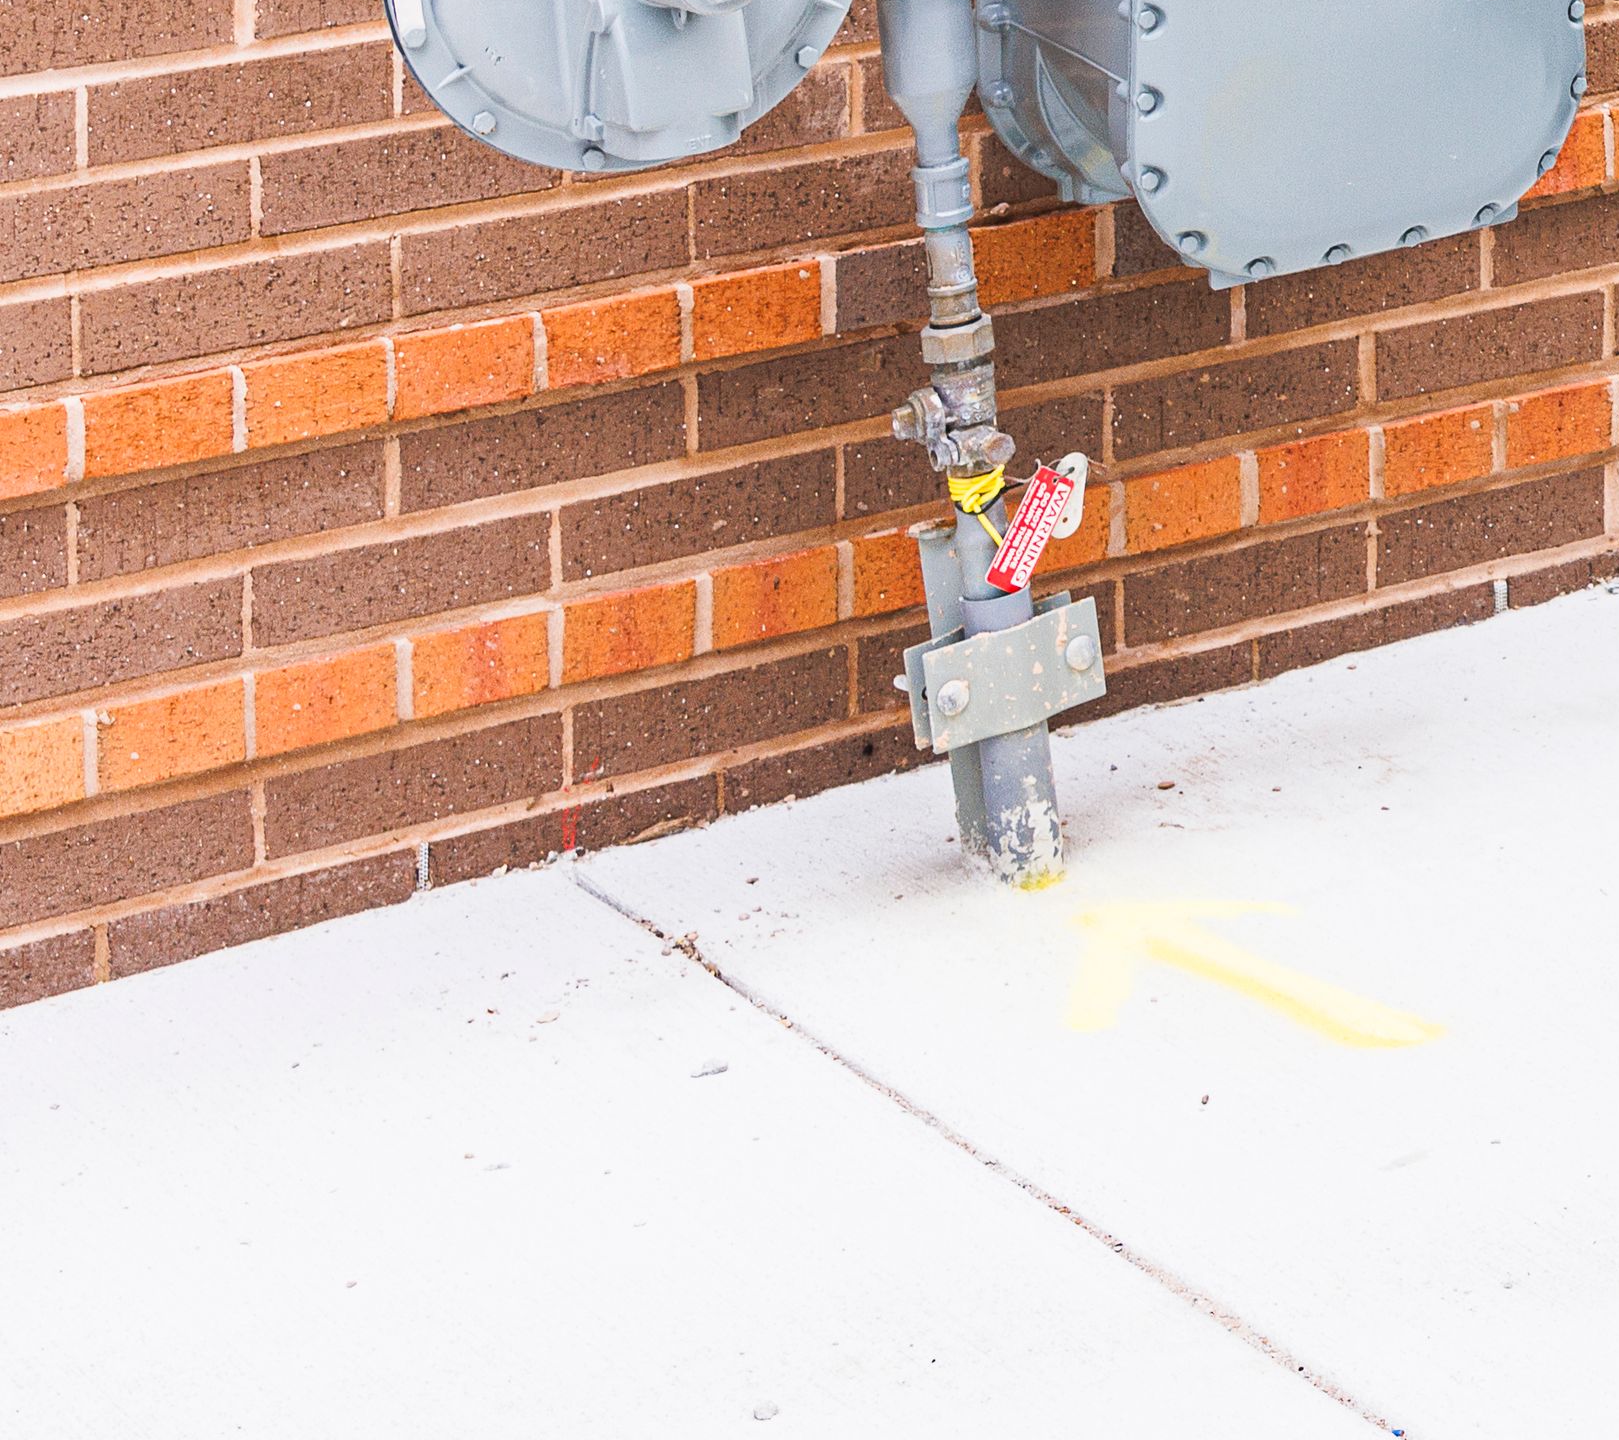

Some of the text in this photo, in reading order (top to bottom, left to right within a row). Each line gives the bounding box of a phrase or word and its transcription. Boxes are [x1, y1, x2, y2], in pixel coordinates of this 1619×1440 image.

[1009, 491, 1051, 570] DO NOT REMOVE
[1011, 525, 1027, 548] THIS
[1016, 490, 1067, 583] WARNING
[1023, 499, 1041, 526] BURY
